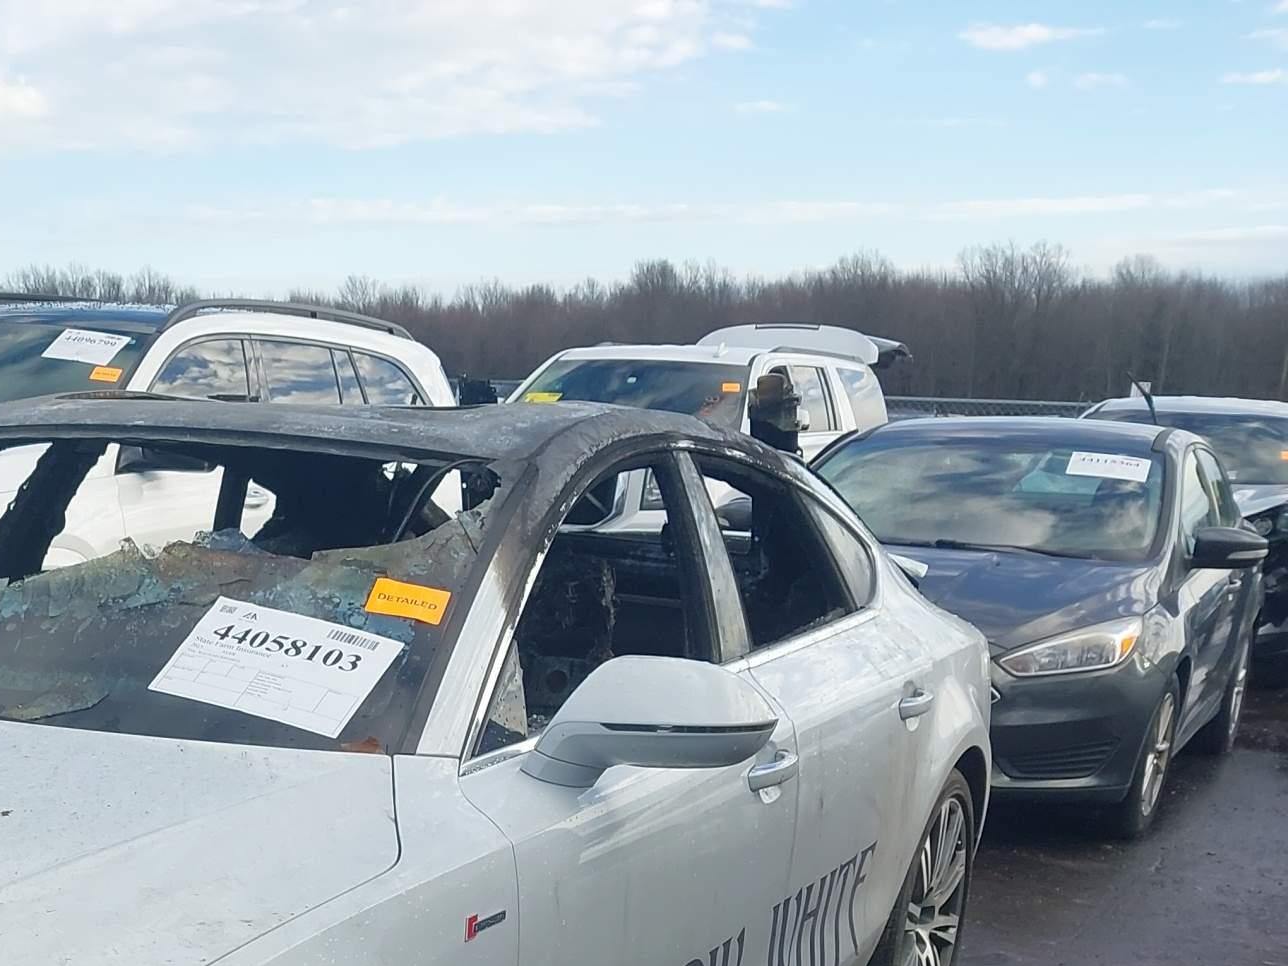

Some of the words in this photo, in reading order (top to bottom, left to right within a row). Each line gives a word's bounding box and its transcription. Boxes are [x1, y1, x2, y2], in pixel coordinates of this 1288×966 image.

[377, 592, 438, 610] DETAILED
[213, 624, 364, 672] 44058103
[215, 641, 235, 651] Farm
